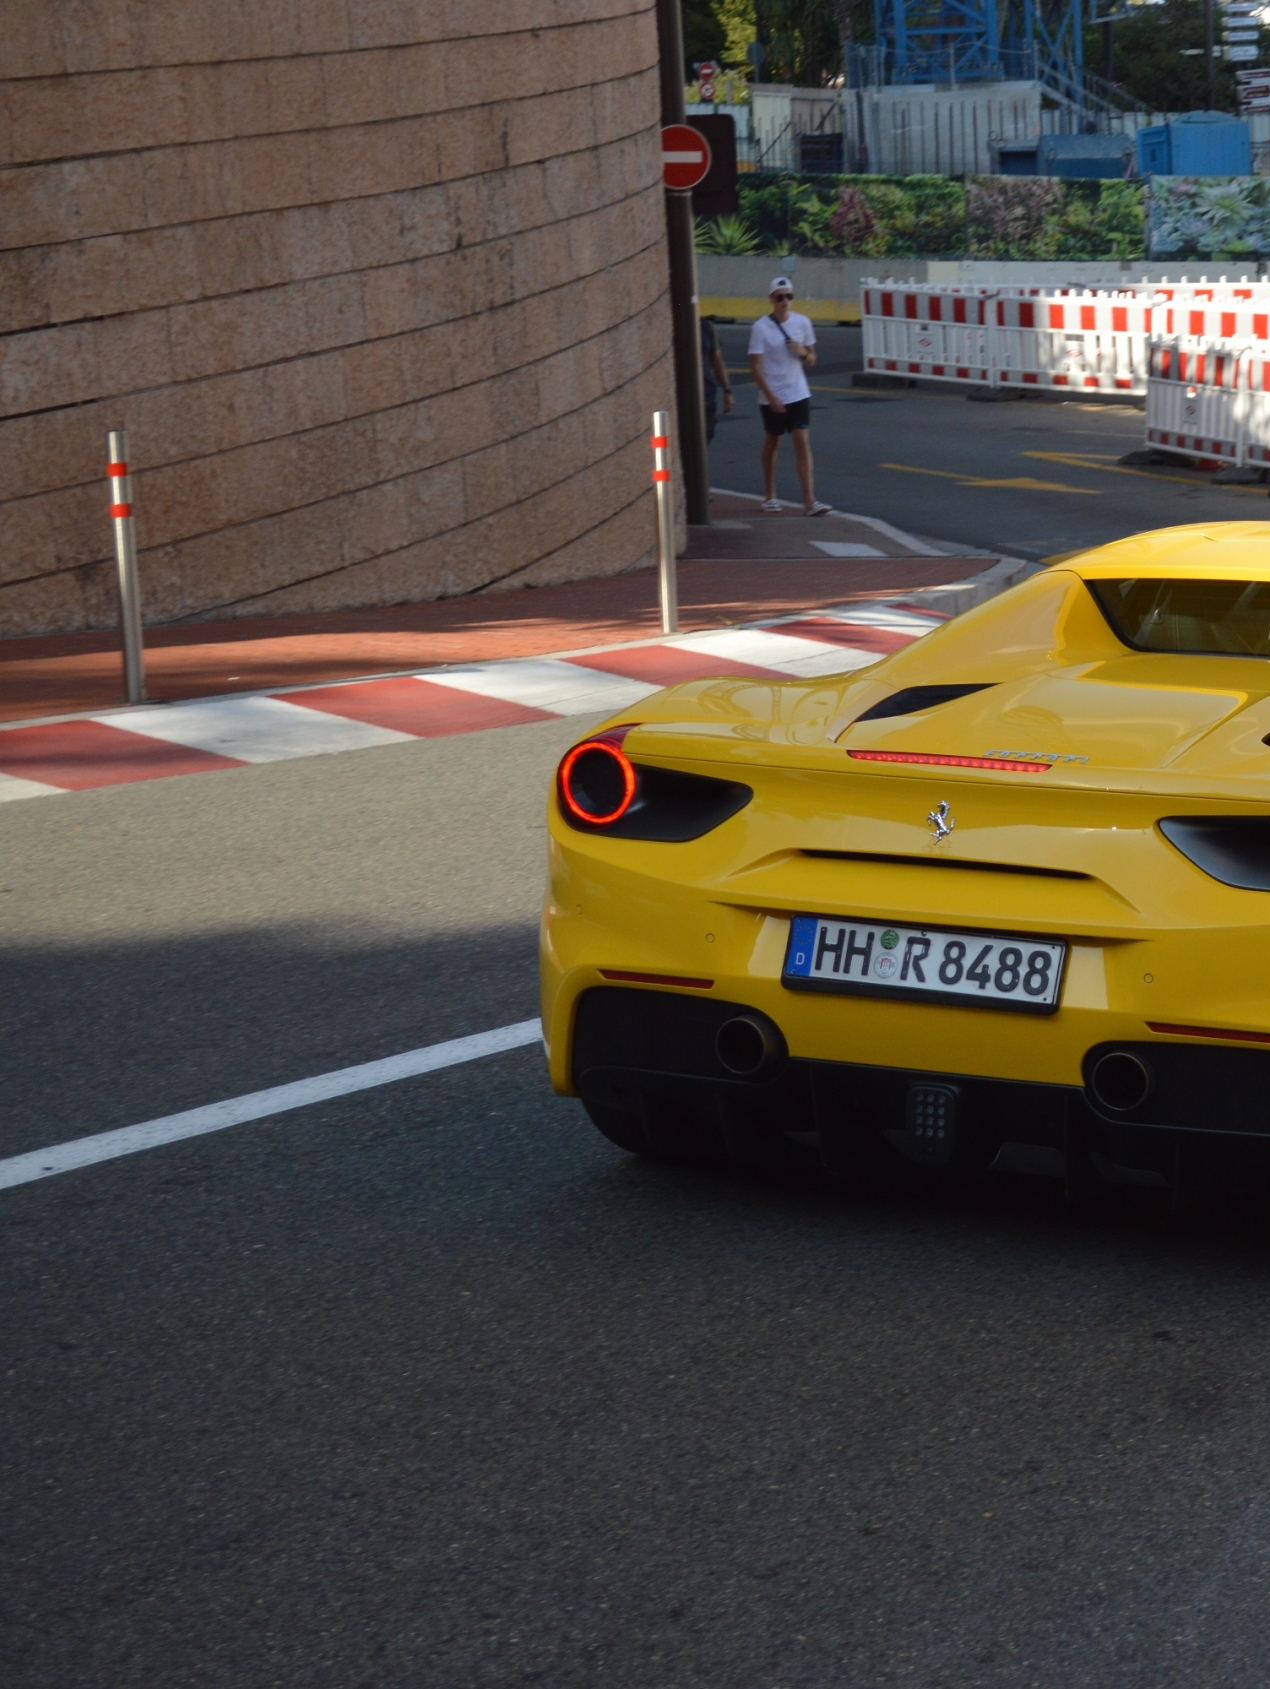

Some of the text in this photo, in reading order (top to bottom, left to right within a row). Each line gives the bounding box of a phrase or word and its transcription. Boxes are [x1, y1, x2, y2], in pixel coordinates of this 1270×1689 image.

[795, 952, 805, 966] D
[814, 926, 875, 976] HH
[900, 935, 931, 983] R
[938, 940, 1053, 996] 8488
